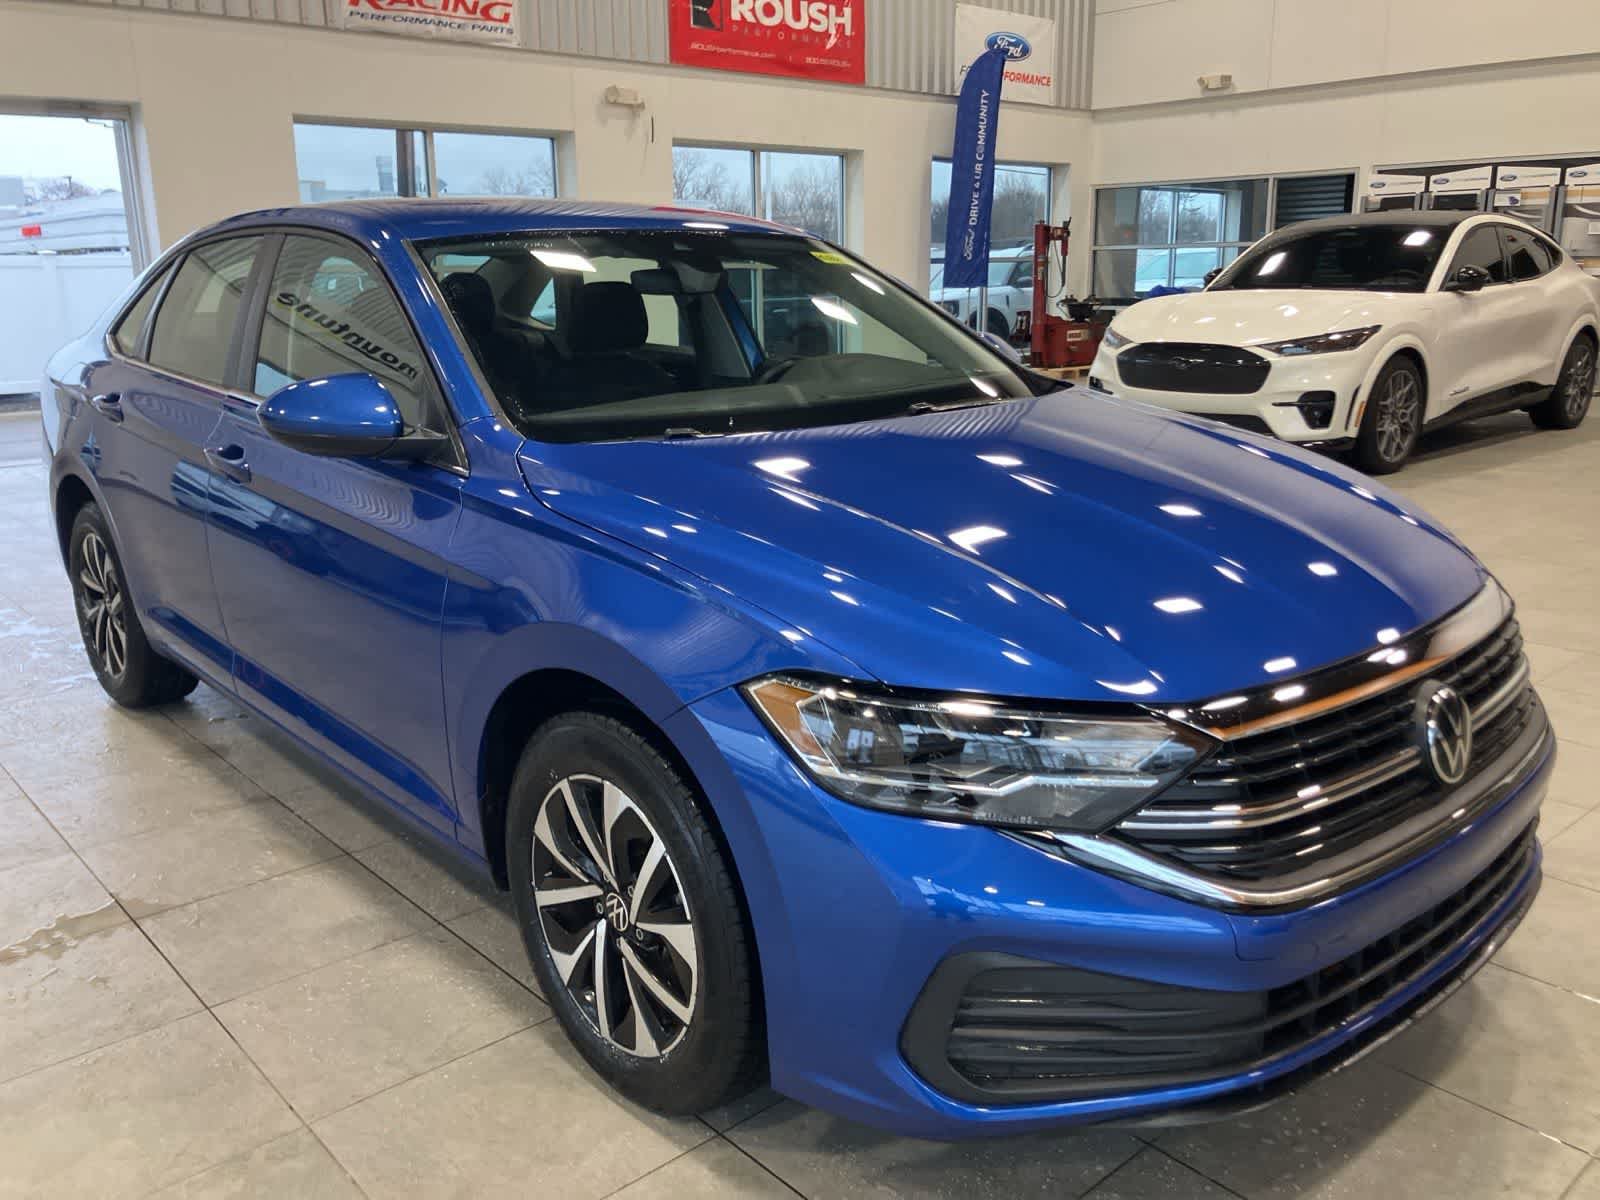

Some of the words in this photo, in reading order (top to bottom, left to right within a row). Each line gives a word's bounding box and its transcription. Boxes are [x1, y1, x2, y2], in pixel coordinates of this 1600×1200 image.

[349, 10, 467, 31] PERFORMANCE
[471, 24, 514, 35] PARTS
[730, 0, 853, 36] ROUSH
[1004, 71, 1052, 87] FORMANCE
[974, 163, 984, 179] UR
[968, 191, 980, 226] DRIVE
[963, 228, 976, 260] Ford
